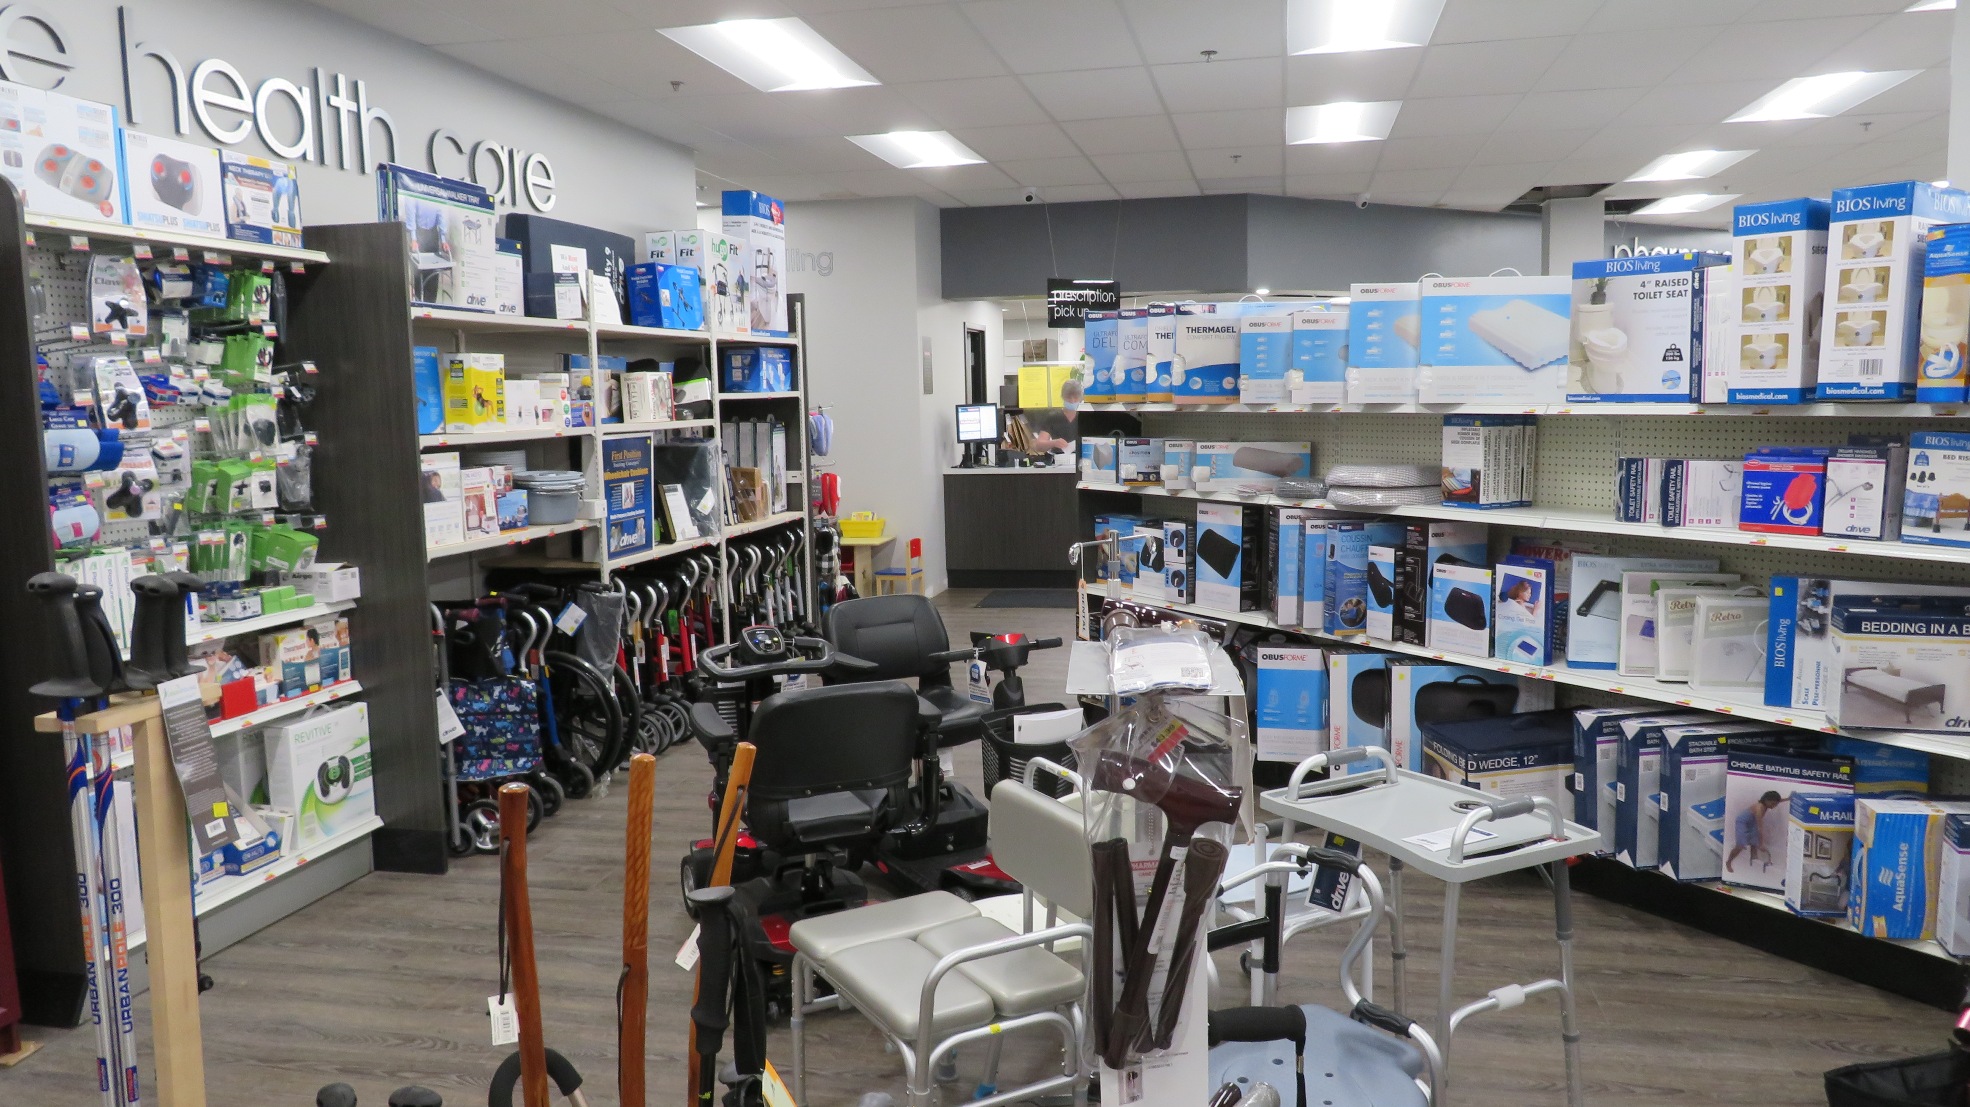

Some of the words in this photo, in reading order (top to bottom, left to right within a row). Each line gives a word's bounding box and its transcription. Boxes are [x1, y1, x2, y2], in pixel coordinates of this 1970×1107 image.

[117, 5, 399, 174] health
[430, 128, 557, 212] care
[1836, 197, 1871, 213] BIOS
[1873, 196, 1906, 212] living
[1738, 212, 1769, 228] BIOS
[1771, 211, 1801, 226] living
[650, 250, 665, 259] Fit
[679, 248, 694, 257] Fit
[729, 244, 739, 256] Fit
[1929, 251, 1969, 260] AquaSense
[1606, 260, 1633, 273] BIOS
[1634, 260, 1661, 273] living
[1655, 278, 1689, 288] RAISED
[466, 293, 486, 306] drive
[1053, 288, 1115, 304] prescription
[1632, 290, 1662, 300] TOILET
[1666, 289, 1689, 299] SEAT
[499, 302, 517, 314] drive
[1054, 305, 1075, 319] pick
[1186, 326, 1237, 334] THERMAGEL
[1735, 392, 1788, 401] biosmedical.com
[1826, 387, 1885, 396] biosmedical.com
[1925, 436, 1949, 446] BIOS
[1845, 524, 1871, 533] drive
[1577, 560, 1597, 568] BIOS
[1710, 611, 1742, 623] Retro
[1776, 618, 1791, 642] living
[1861, 621, 1926, 634] BEDDING
[1931, 623, 1945, 634] IN
[1948, 624, 1959, 635] A
[1261, 653, 1307, 662] OBUSFORME
[1774, 642, 1786, 668] BIOS
[1945, 715, 1970, 729] dri
[294, 723, 332, 744] REVITIVE
[1434, 742, 1457, 764] FOLDING
[1459, 757, 1476, 771] BED
[1479, 756, 1520, 769] WEDGE,
[1731, 760, 1764, 771] CHROME
[1765, 764, 1800, 775] BATHTUB
[1802, 769, 1831, 779] SAFETY
[1832, 773, 1850, 781] RAIL
[1819, 811, 1854, 822] M-RAIL
[1893, 843, 1910, 912] AquaSense
[77, 872, 90, 908] 300
[109, 877, 123, 915] 300
[1331, 872, 1349, 910] drive
